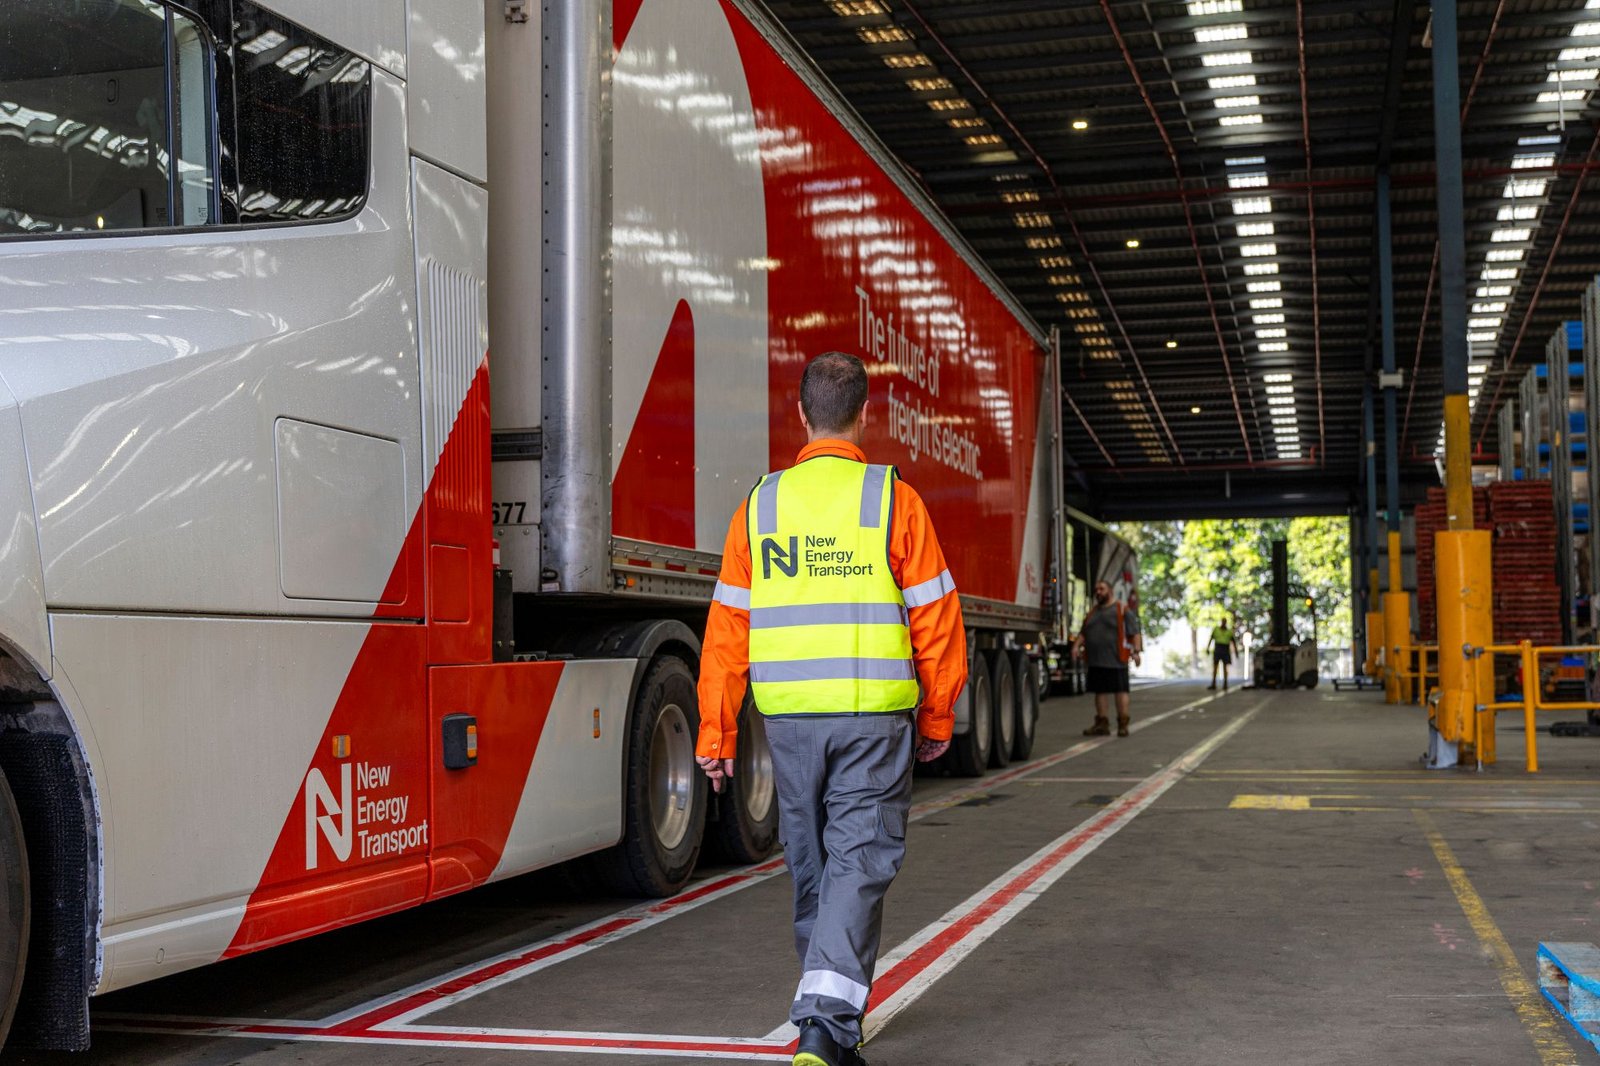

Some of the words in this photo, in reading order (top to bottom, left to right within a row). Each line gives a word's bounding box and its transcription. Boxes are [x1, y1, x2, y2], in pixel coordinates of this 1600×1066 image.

[856, 285, 885, 361] The
[887, 312, 926, 389] future
[928, 349, 940, 398] of
[888, 382, 930, 462] freight
[931, 407, 942, 461] is
[942, 421, 983, 481] electric.
[805, 535, 836, 547] New
[805, 550, 853, 563] Energy
[806, 563, 873, 578] Transport
[356, 761, 391, 791] New
[357, 795, 409, 825] Energy
[357, 819, 428, 859] Transport
